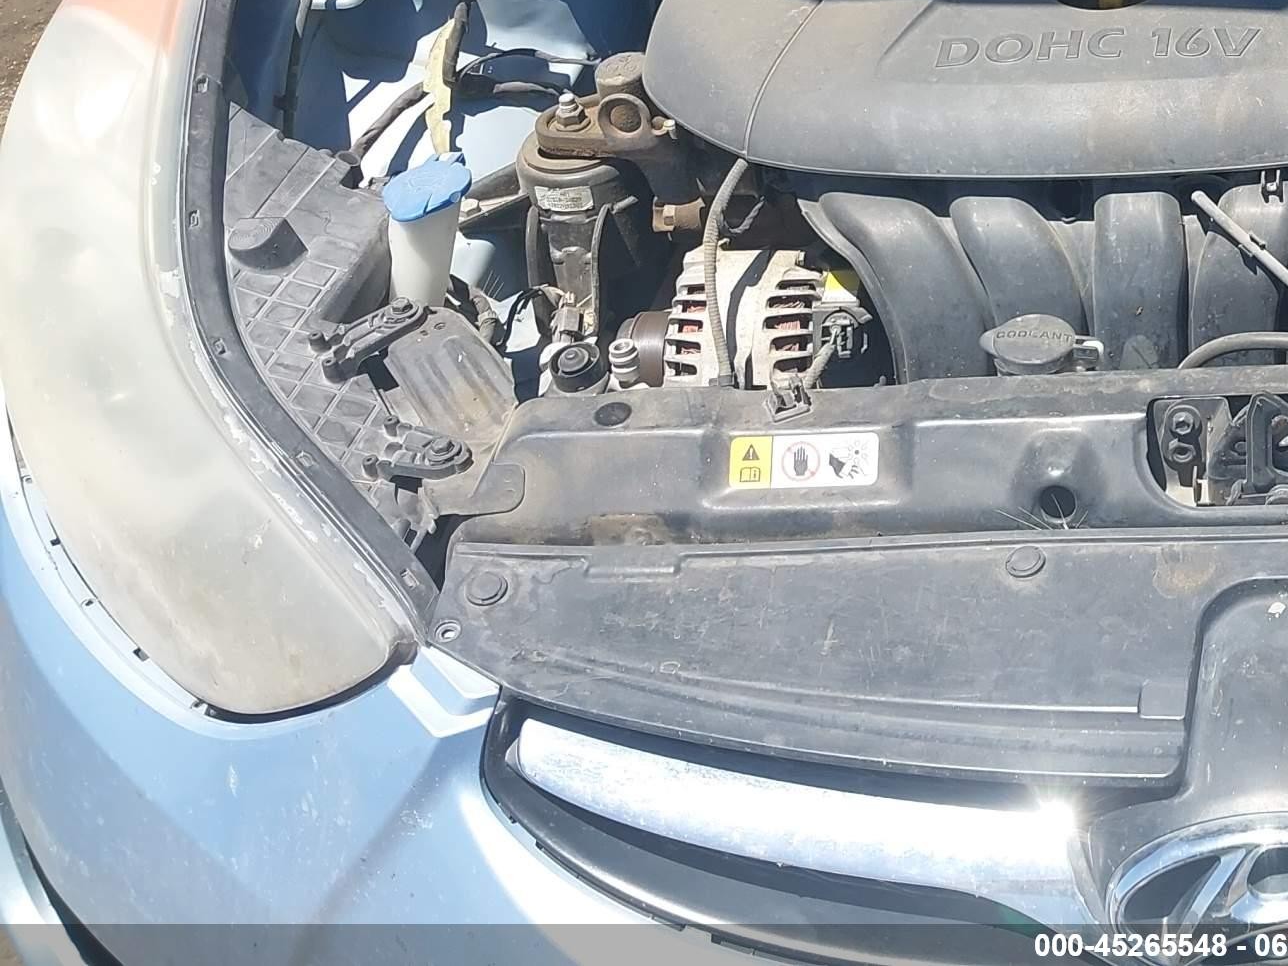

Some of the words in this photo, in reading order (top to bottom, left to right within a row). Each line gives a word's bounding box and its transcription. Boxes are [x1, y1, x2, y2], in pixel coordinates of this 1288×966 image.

[935, 27, 1126, 68] DOHC
[1151, 26, 1263, 58] 16V
[996, 329, 1073, 344] COOLANT
